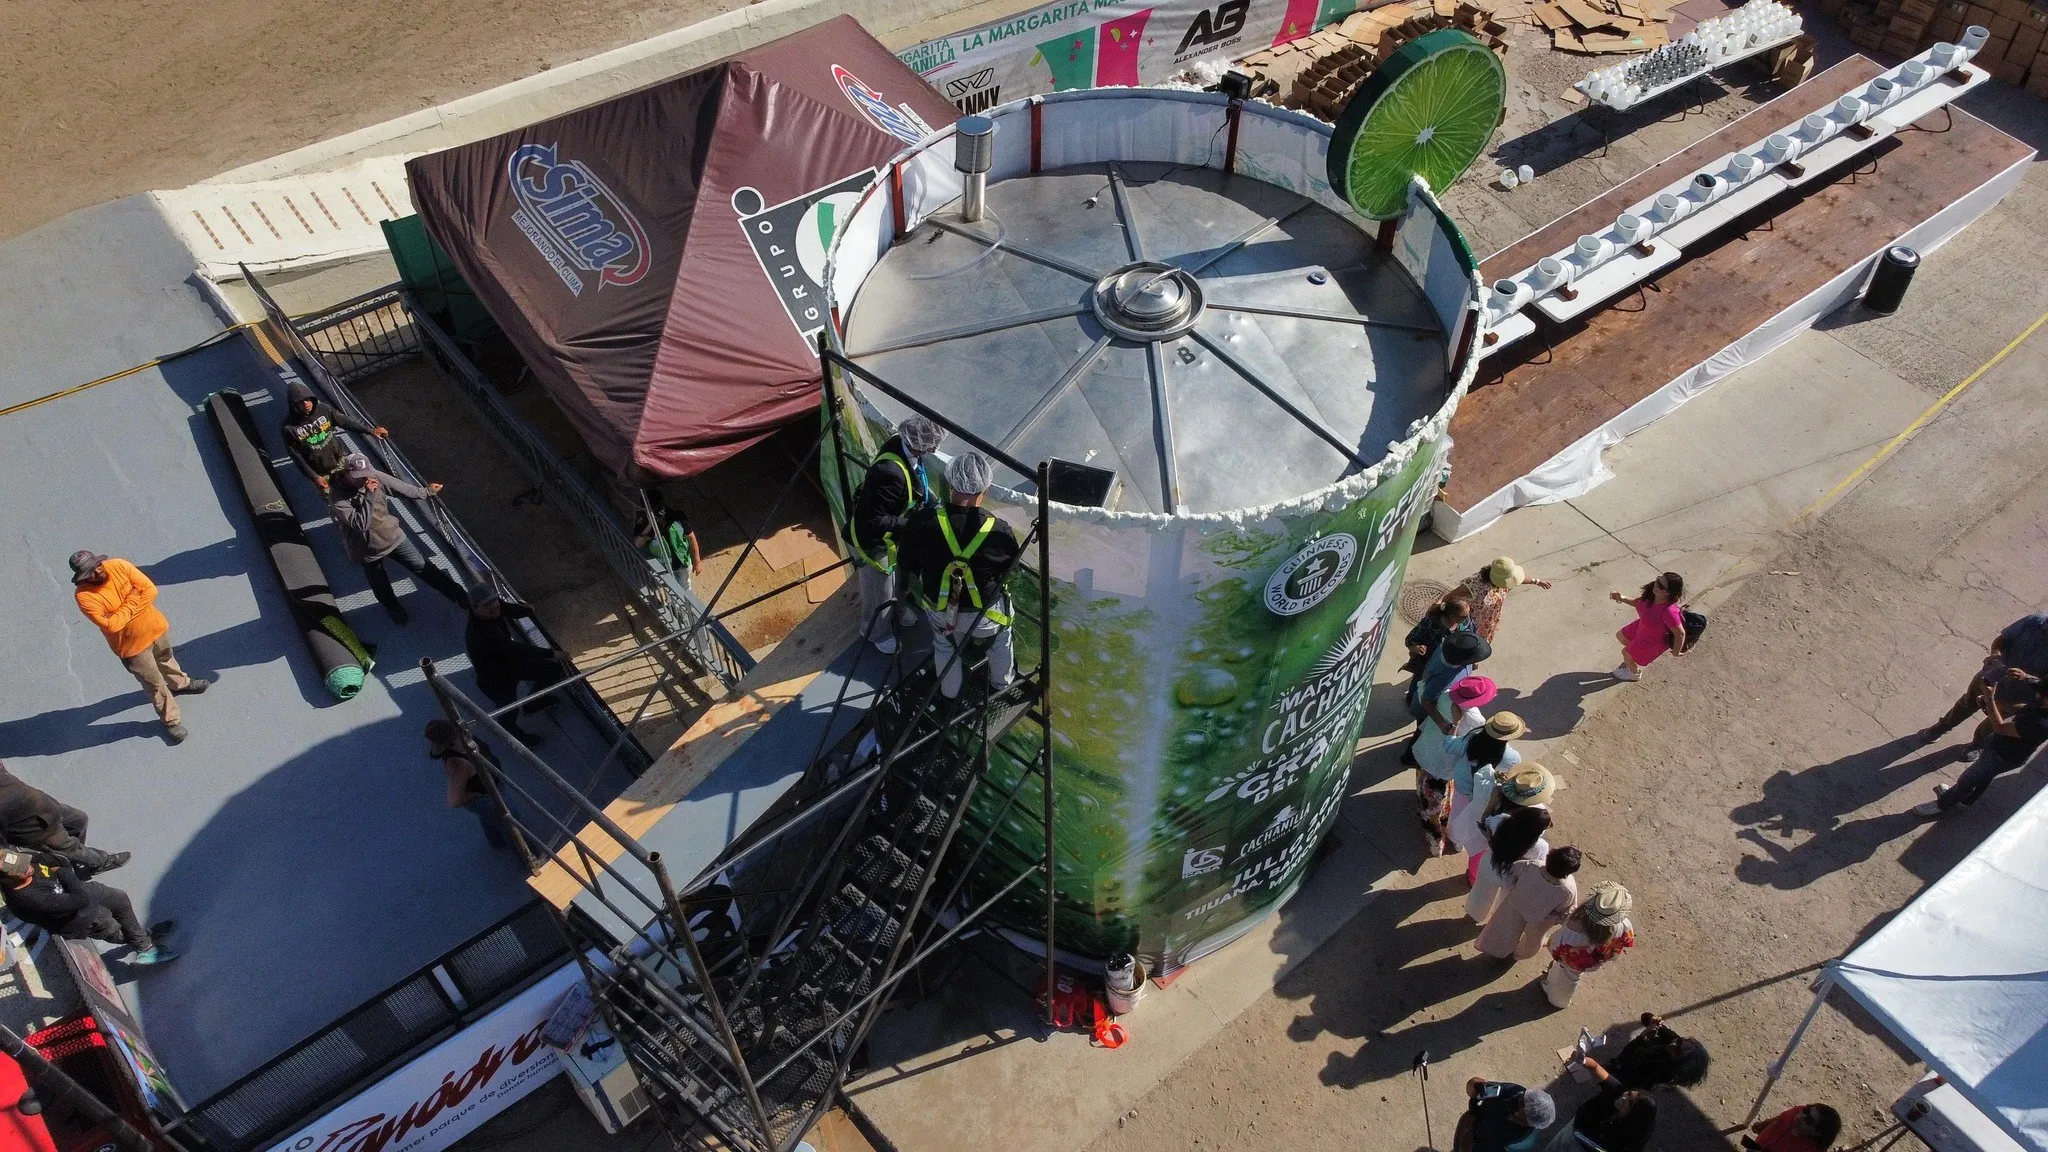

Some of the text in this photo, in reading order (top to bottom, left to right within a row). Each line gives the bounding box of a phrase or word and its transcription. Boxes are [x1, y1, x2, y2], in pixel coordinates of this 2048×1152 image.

[962, 36, 984, 53] LA
[988, 5, 1089, 45] MARGARITA
[1172, 36, 1242, 65] ALEXANDER BOSS
[907, 47, 956, 74] ANILLA
[955, 85, 1000, 117] ANNY
[519, 163, 634, 271] Sima
[514, 211, 582, 293] MEJORANDO EL CLIMA
[758, 220, 819, 321] GRUPO
[1271, 552, 1351, 611] WORLD RECORDS
[1283, 538, 1348, 575] GUINNESS
[1279, 608, 1391, 715] MARGARI
[1236, 695, 1363, 800] GRAN
[1267, 752, 1286, 769] LA
[1254, 773, 1299, 805] DEL
[1240, 801, 1310, 857] CACHANILLA
[1184, 878, 1264, 920] TIJUANA,
[1268, 845, 1303, 879] BAJA
[1231, 833, 1304, 889] JULIO
[429, 1103, 475, 1137] parque
[478, 1087, 496, 1111] de
[499, 1051, 556, 1091] diversion
